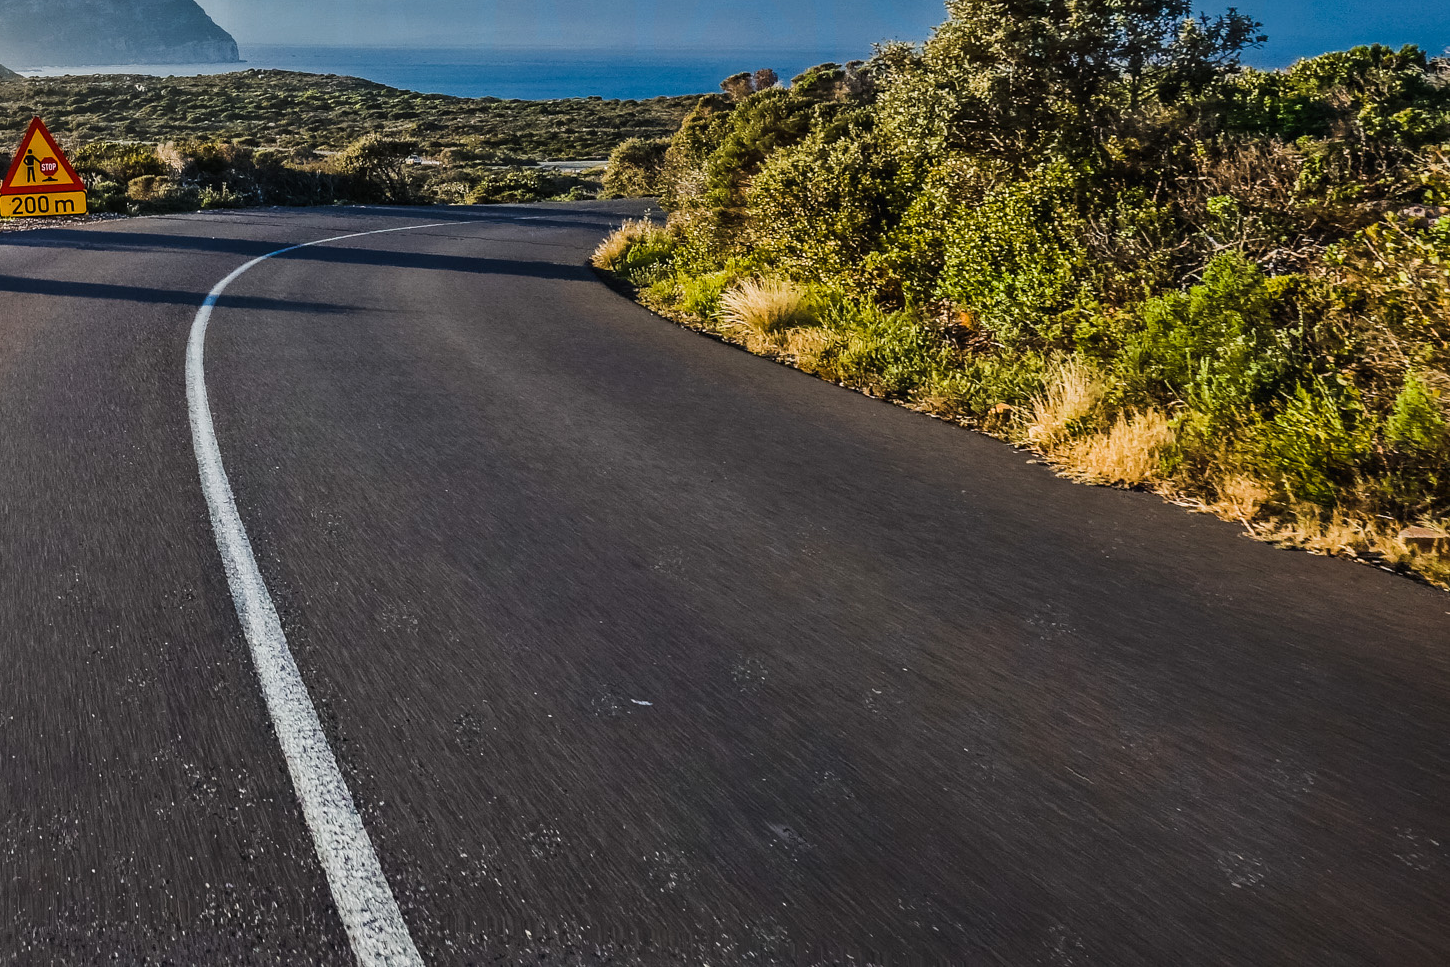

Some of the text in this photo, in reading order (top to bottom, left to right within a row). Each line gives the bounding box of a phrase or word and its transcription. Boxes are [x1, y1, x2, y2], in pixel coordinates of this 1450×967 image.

[41, 163, 57, 171] STOP
[11, 195, 75, 215] 200 m
